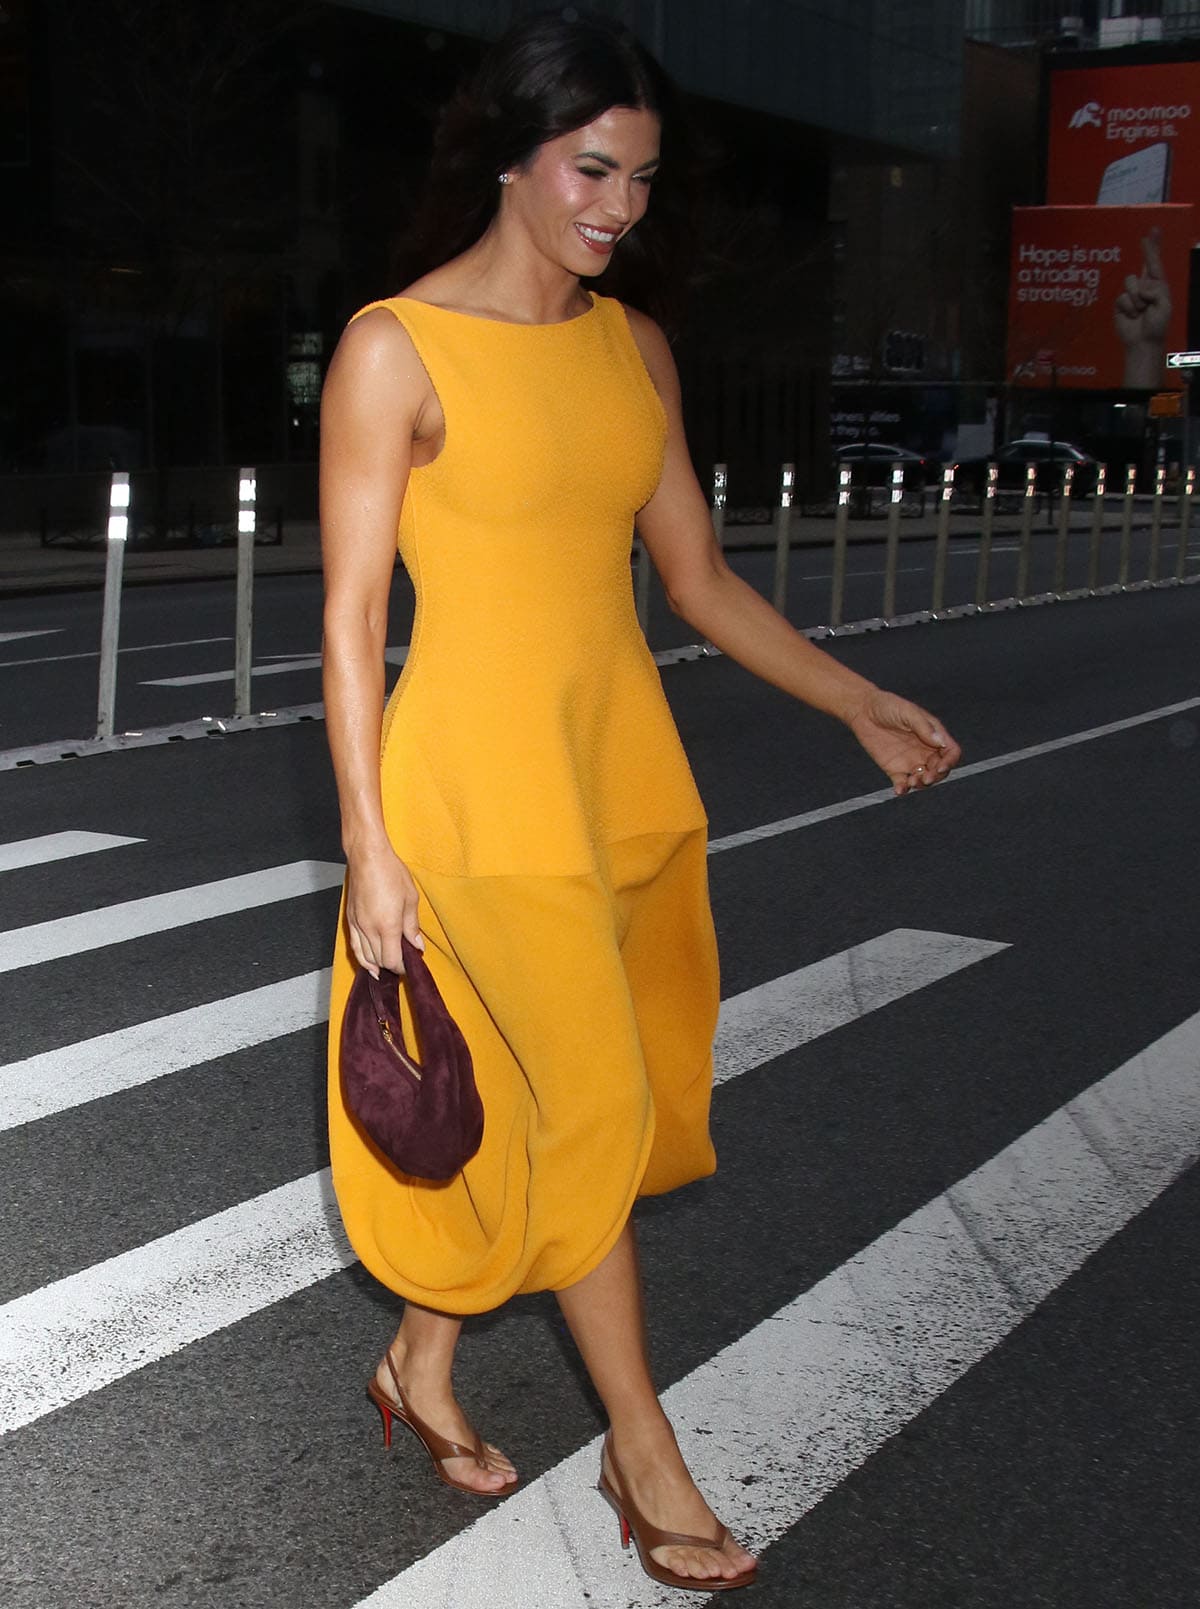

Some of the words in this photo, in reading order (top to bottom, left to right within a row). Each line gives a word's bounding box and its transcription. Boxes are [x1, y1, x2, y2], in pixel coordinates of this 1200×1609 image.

[1107, 104, 1191, 121] moomoo
[1106, 123, 1159, 143] Engine
[1019, 245, 1070, 265] Hope
[1072, 244, 1087, 262] is
[1089, 246, 1121, 262] not
[1018, 269, 1031, 283] a
[1033, 265, 1100, 287] trading
